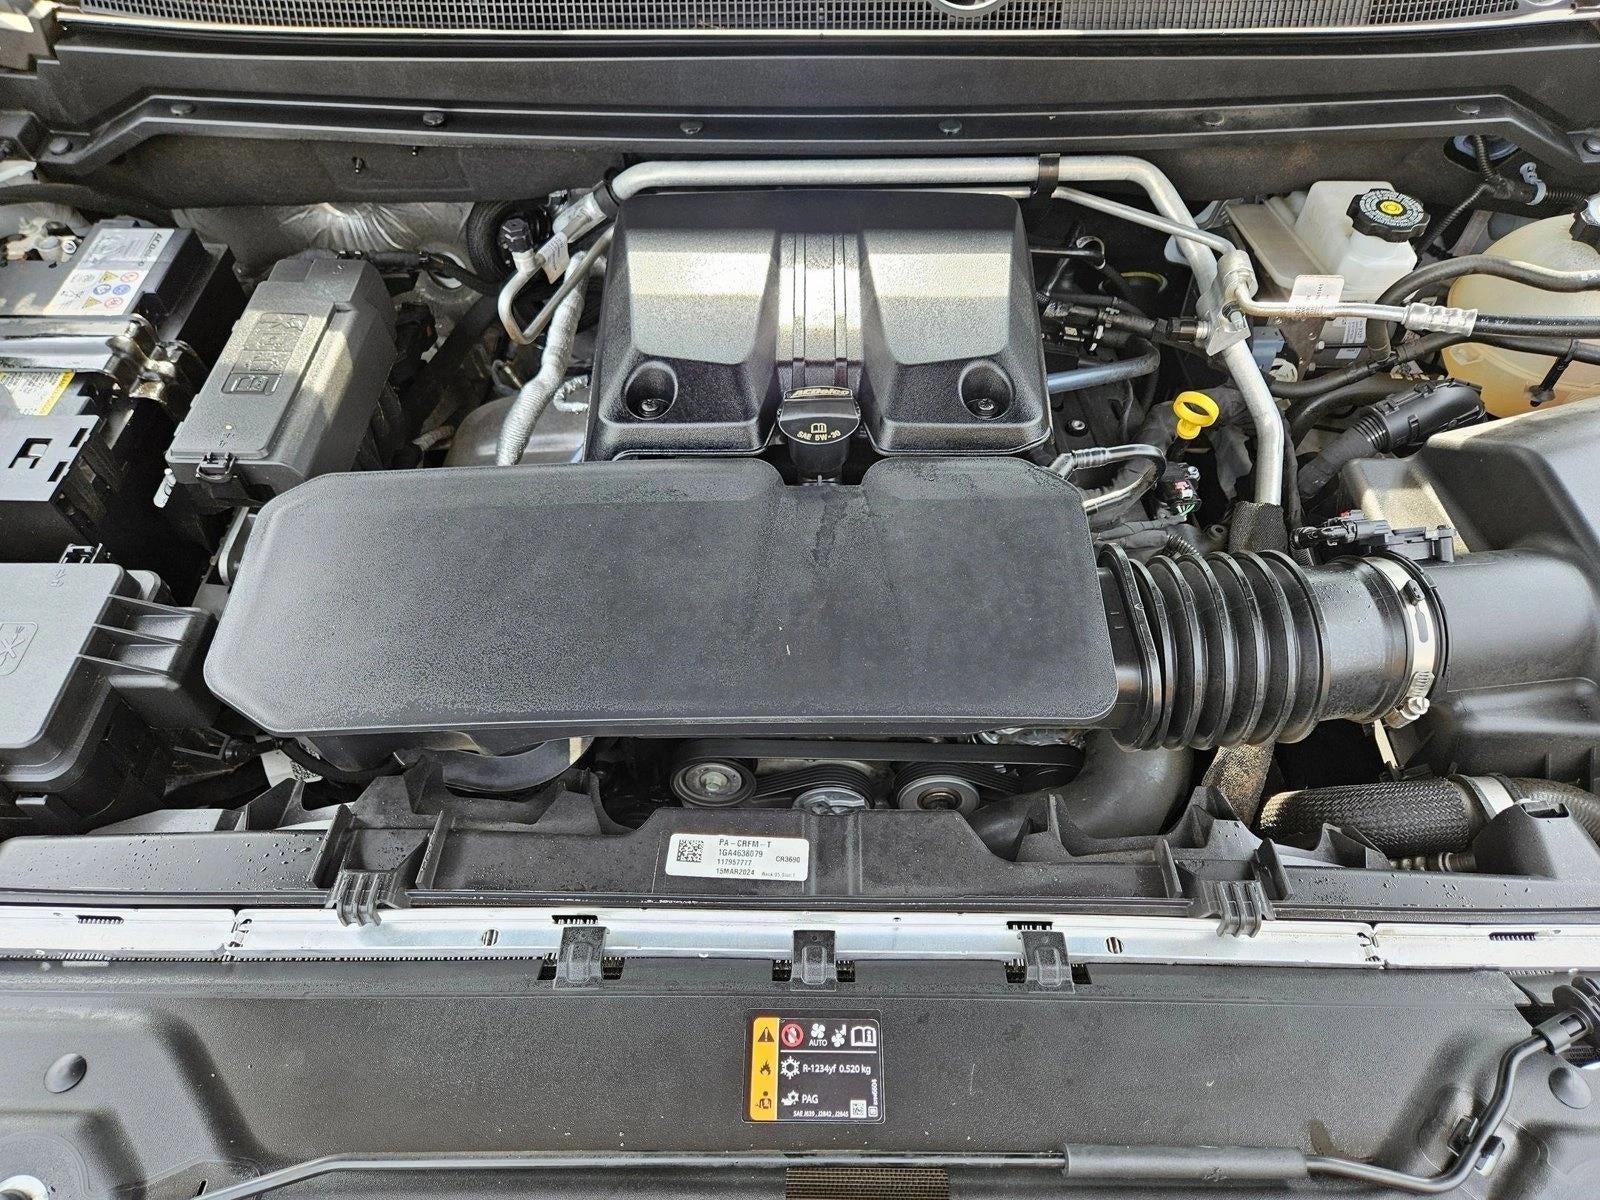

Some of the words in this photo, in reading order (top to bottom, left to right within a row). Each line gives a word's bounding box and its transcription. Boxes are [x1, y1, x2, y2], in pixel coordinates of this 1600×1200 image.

[797, 430, 812, 441] SAE
[815, 429, 841, 441] 5W-30
[775, 855, 801, 863] CR3690
[716, 868, 755, 877] 15MAR2024
[808, 1039, 828, 1047] AUTO
[802, 1063, 837, 1075] R-1234yf
[839, 1064, 860, 1074] 0.520
[861, 1063, 872, 1076] kg
[801, 1094, 819, 1104] PAG
